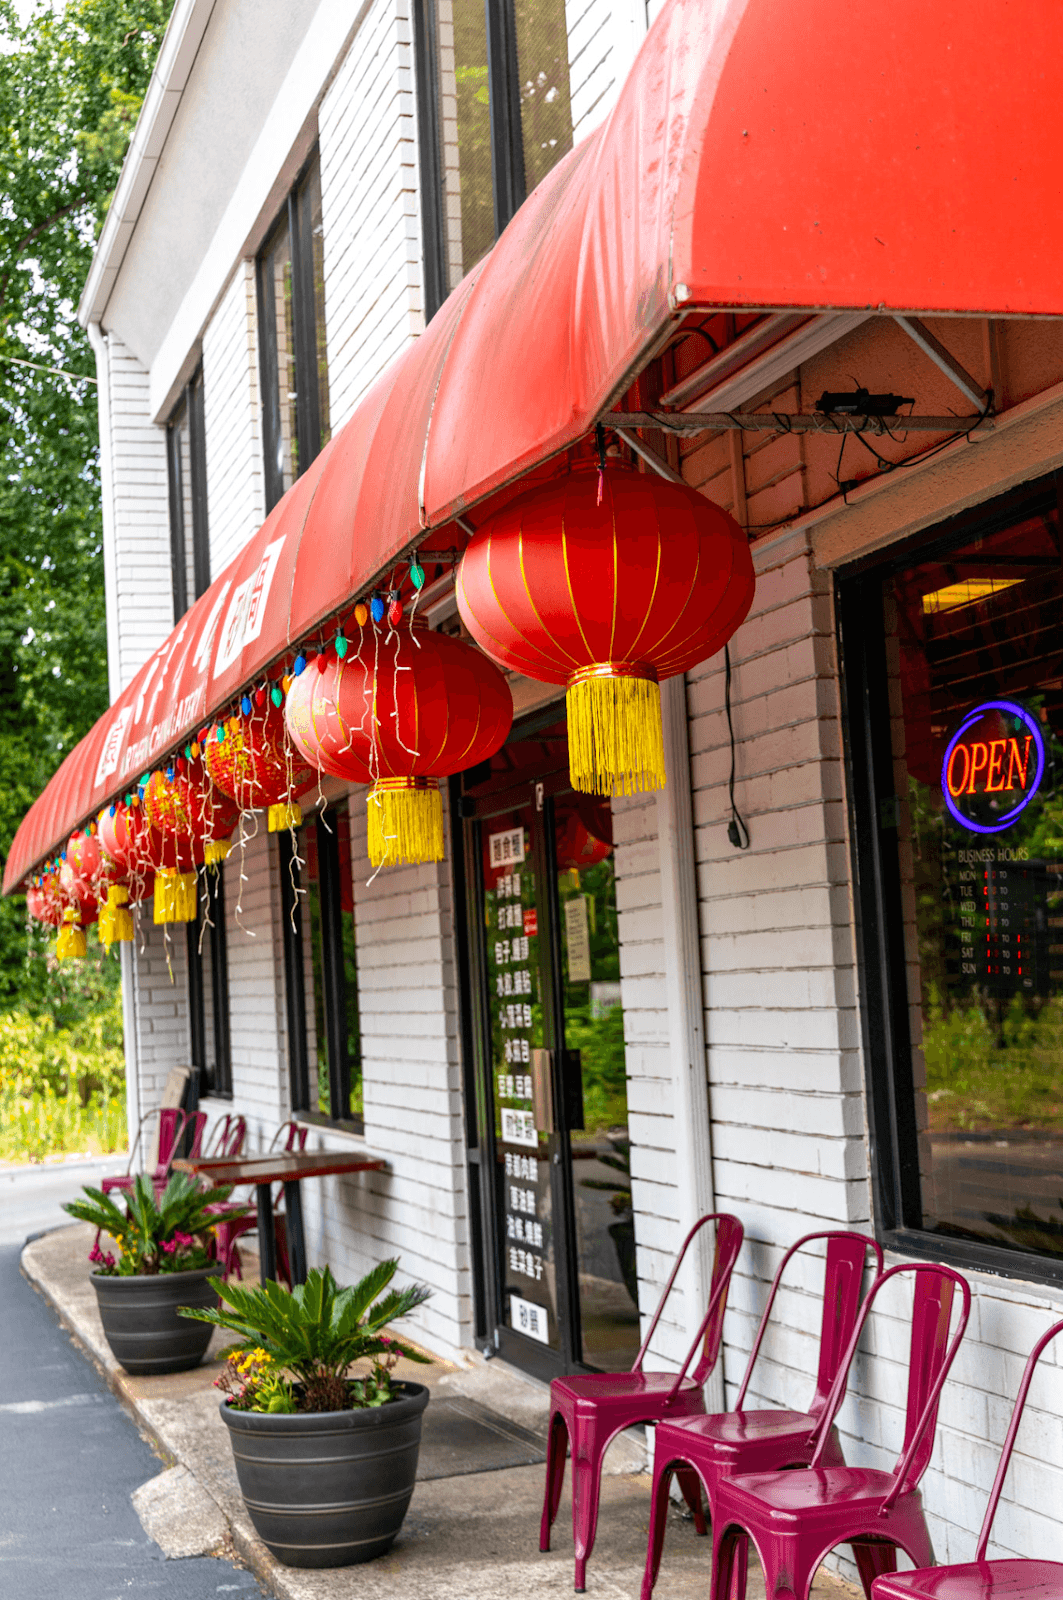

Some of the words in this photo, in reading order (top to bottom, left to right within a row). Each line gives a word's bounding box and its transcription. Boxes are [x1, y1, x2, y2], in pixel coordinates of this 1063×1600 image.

[947, 735, 1033, 797] OPEN
[958, 849, 995, 863] BUSINESS
[997, 847, 1029, 861] HOURS
[960, 871, 976, 881] MON
[960, 886, 973, 897] TUE
[960, 901, 976, 912] WED
[961, 917, 975, 928] THU
[961, 933, 972, 943] FRI
[961, 947, 974, 958] SAT
[962, 962, 976, 974] SUN
[510, 1247, 544, 1282] 韭菜盒子
